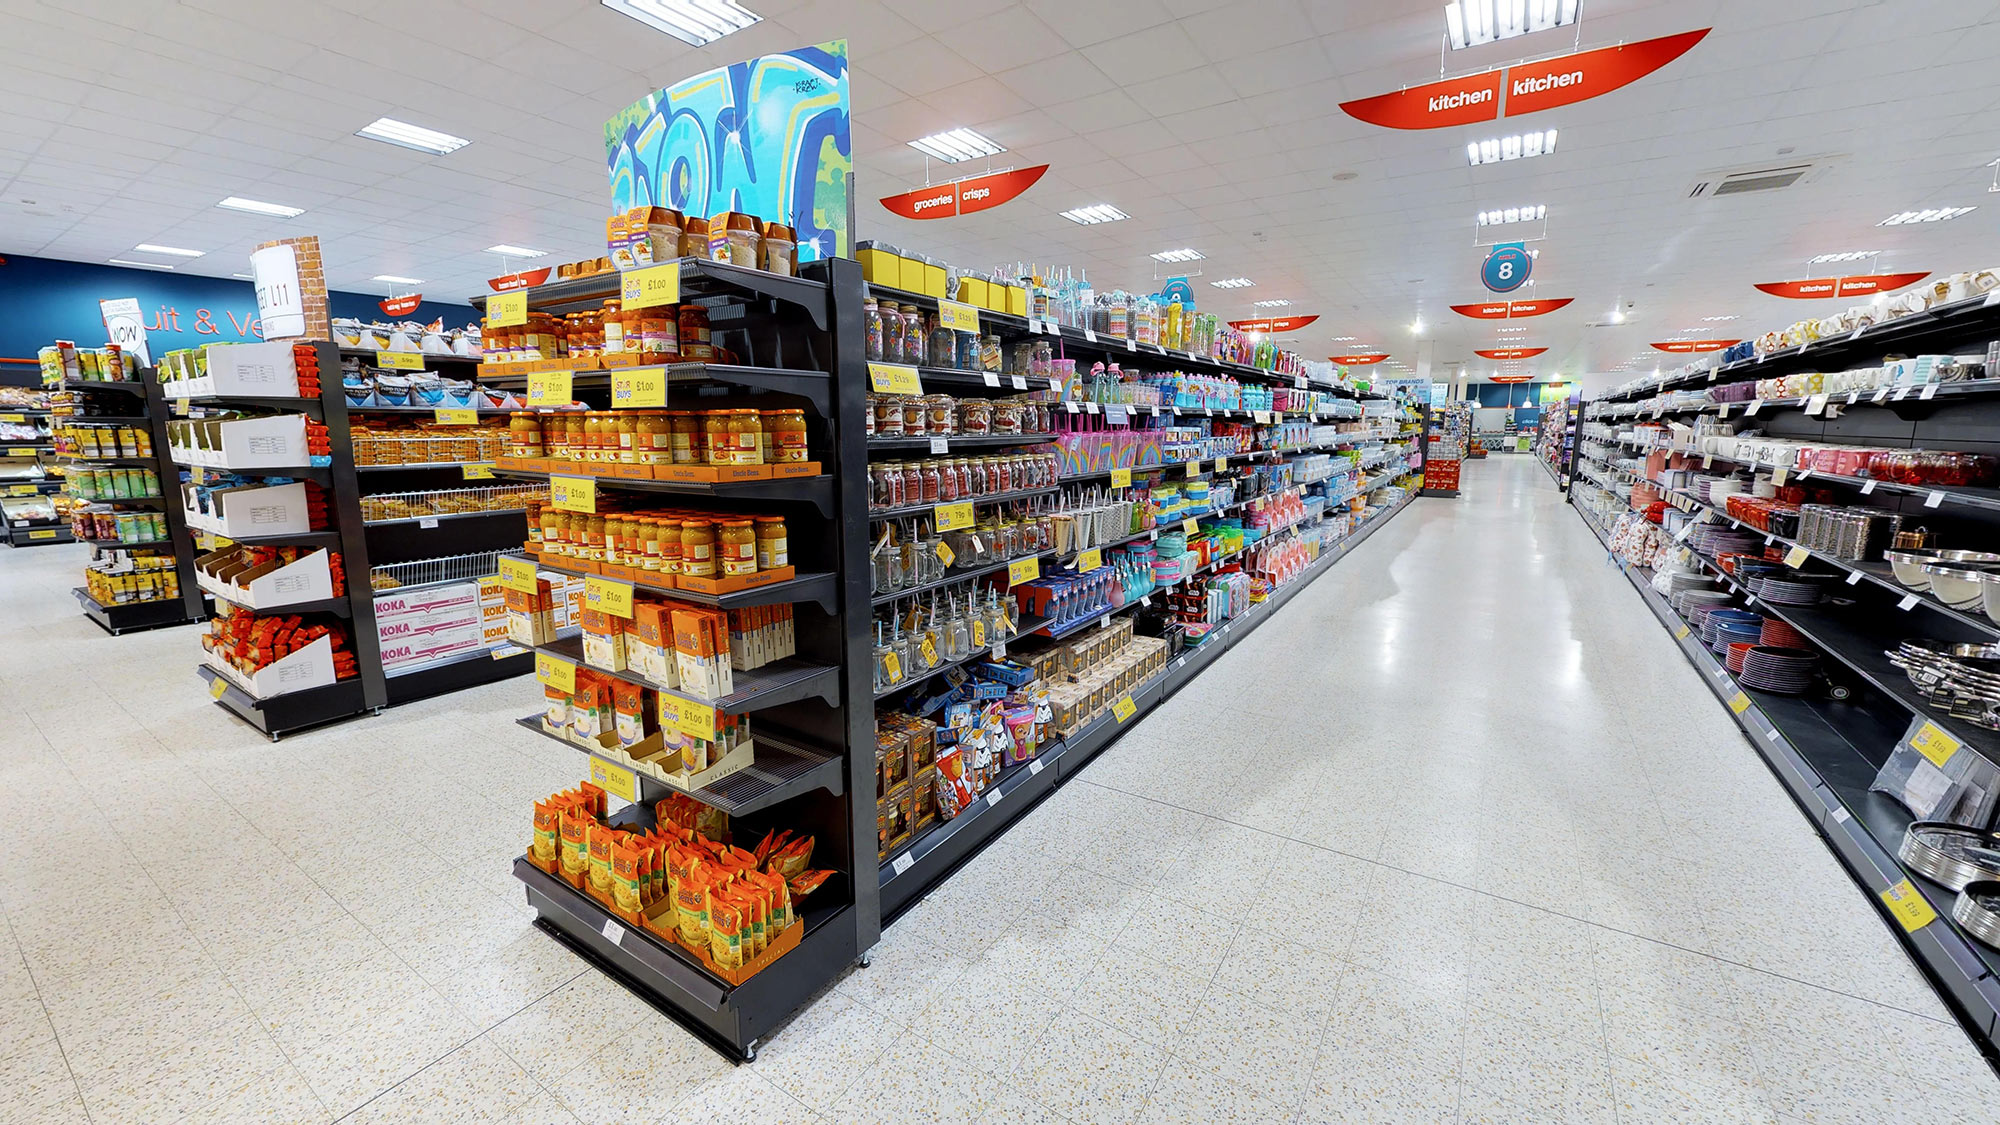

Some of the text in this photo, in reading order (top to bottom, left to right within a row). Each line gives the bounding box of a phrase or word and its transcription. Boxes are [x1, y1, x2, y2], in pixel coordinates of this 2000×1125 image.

[1428, 70, 1583, 112] kitchen kitchen
[914, 188, 990, 213] groceries crisps
[1498, 262, 1513, 280] 8
[648, 279, 666, 291] £1.00
[1800, 281, 1877, 293] kitchen kitchen
[194, 308, 220, 335] &
[112, 325, 137, 343] WOW
[548, 383, 563, 392] £1.00
[636, 380, 654, 392] £1.00
[571, 489, 586, 499] £1.00
[516, 570, 529, 581] £1.00
[606, 590, 622, 603] £1.00
[375, 600, 406, 613] KOKA
[380, 623, 410, 637] KOKA
[484, 626, 509, 638] KOKA
[381, 646, 411, 660] KOKA
[553, 666, 567, 679] £1.00
[684, 710, 702, 724] £1.00
[710, 764, 739, 780] CLASSIC
[611, 772, 626, 787] £1.00
[757, 947, 785, 967] SPECIAL
